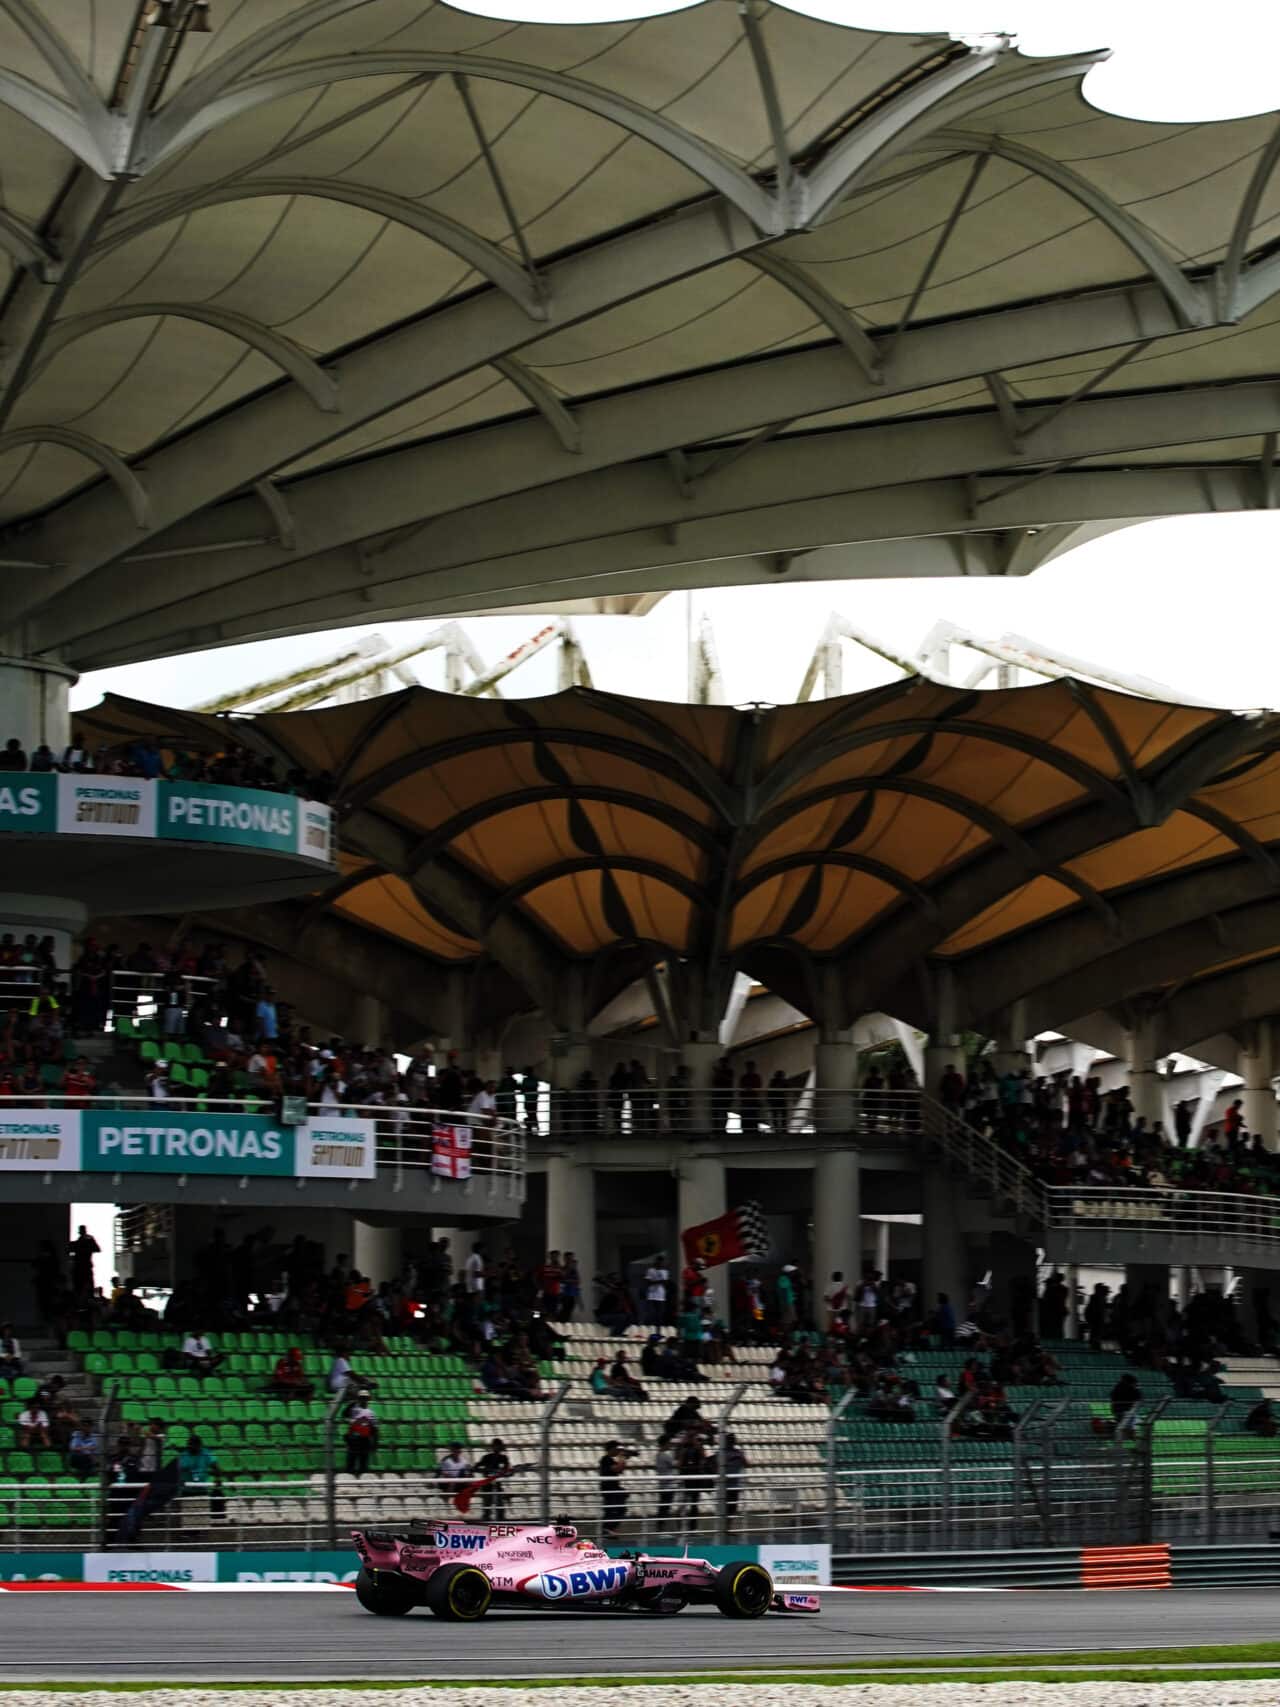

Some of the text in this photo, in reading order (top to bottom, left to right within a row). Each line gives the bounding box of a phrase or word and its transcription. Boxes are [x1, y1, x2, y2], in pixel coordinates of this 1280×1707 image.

[76, 787, 141, 800] PETRONAS
[168, 796, 291, 836] PETRONAS
[98, 1126, 281, 1159] PETRONAS
[311, 1130, 366, 1143] PETRONAS
[450, 1535, 487, 1549] BWT
[526, 1535, 553, 1545] NEC
[107, 1569, 193, 1582] PETRONAS
[641, 1567, 677, 1579] AHARA
[569, 1566, 628, 1596] BWT
